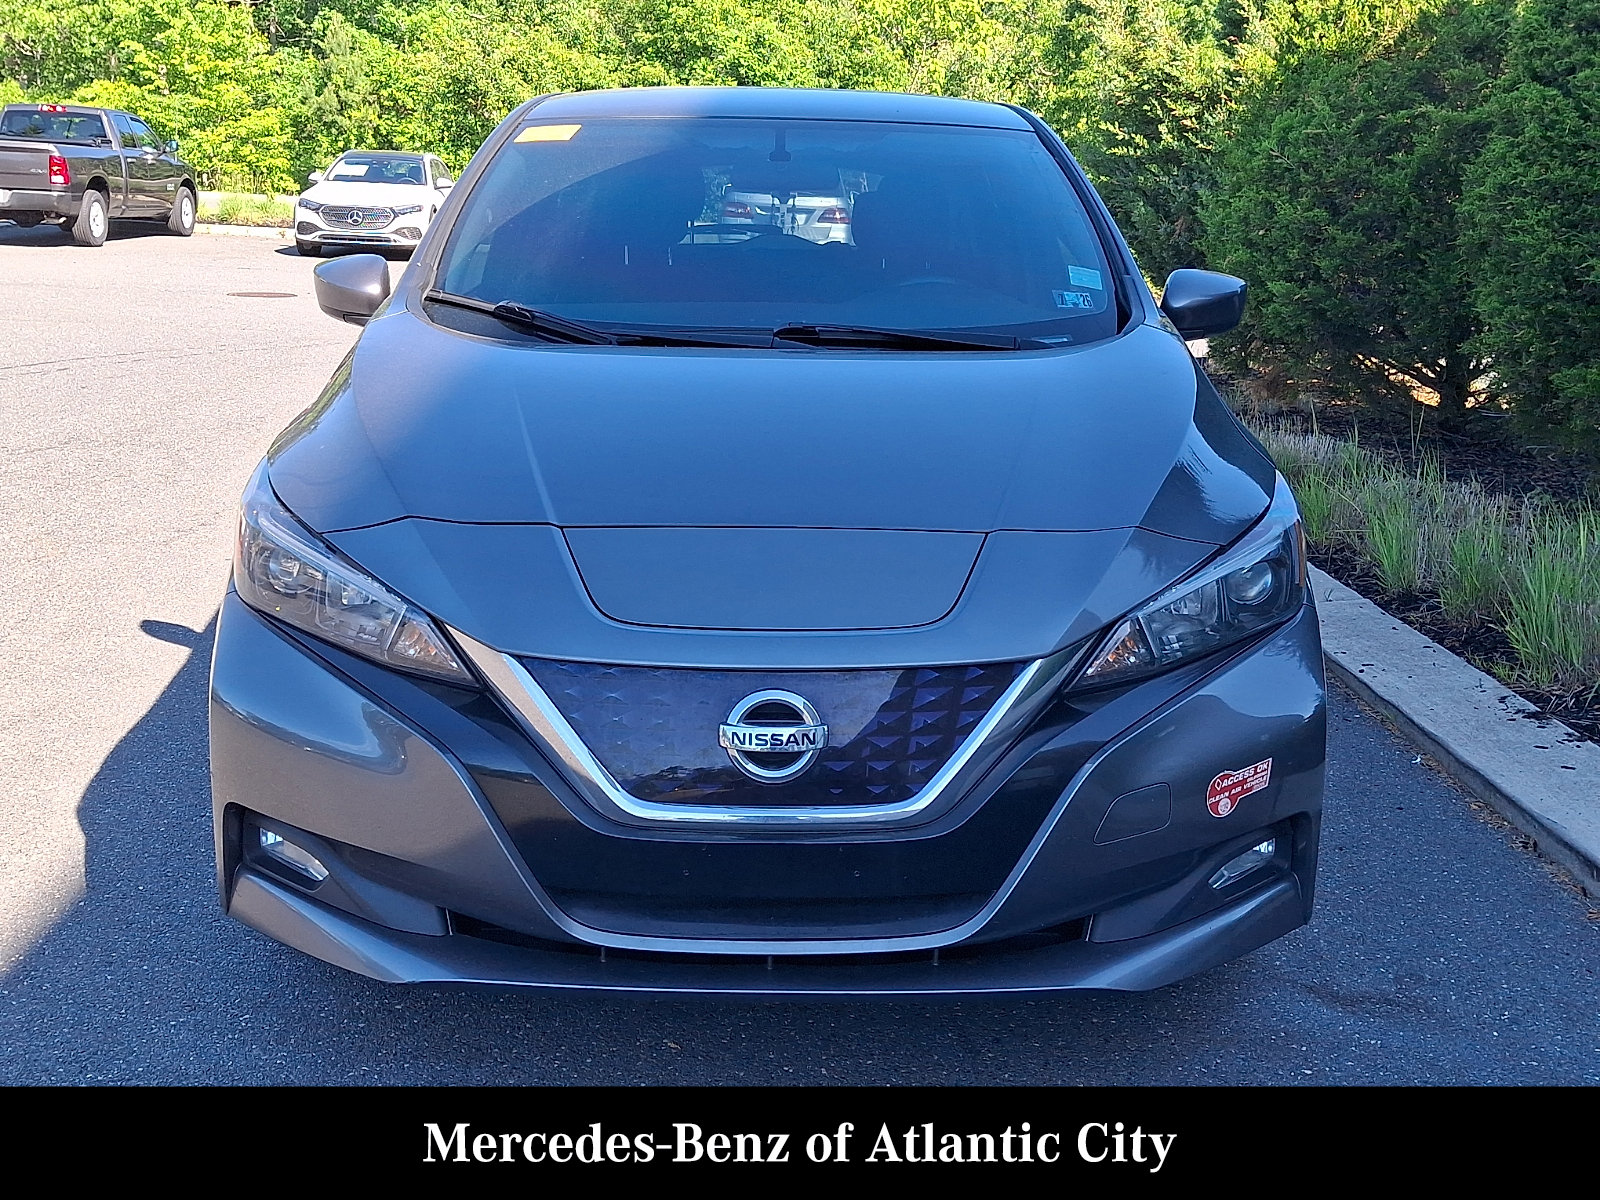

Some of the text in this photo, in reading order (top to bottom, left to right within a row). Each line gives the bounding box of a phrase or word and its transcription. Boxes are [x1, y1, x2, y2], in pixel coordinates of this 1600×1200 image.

[731, 732, 816, 747] NISSAN
[1222, 768, 1255, 788] ACCESS
[1256, 762, 1269, 773] OK
[1208, 791, 1230, 804] CLEAN
[1230, 786, 1242, 796] AIR
[1243, 775, 1267, 790] VEHICLE
